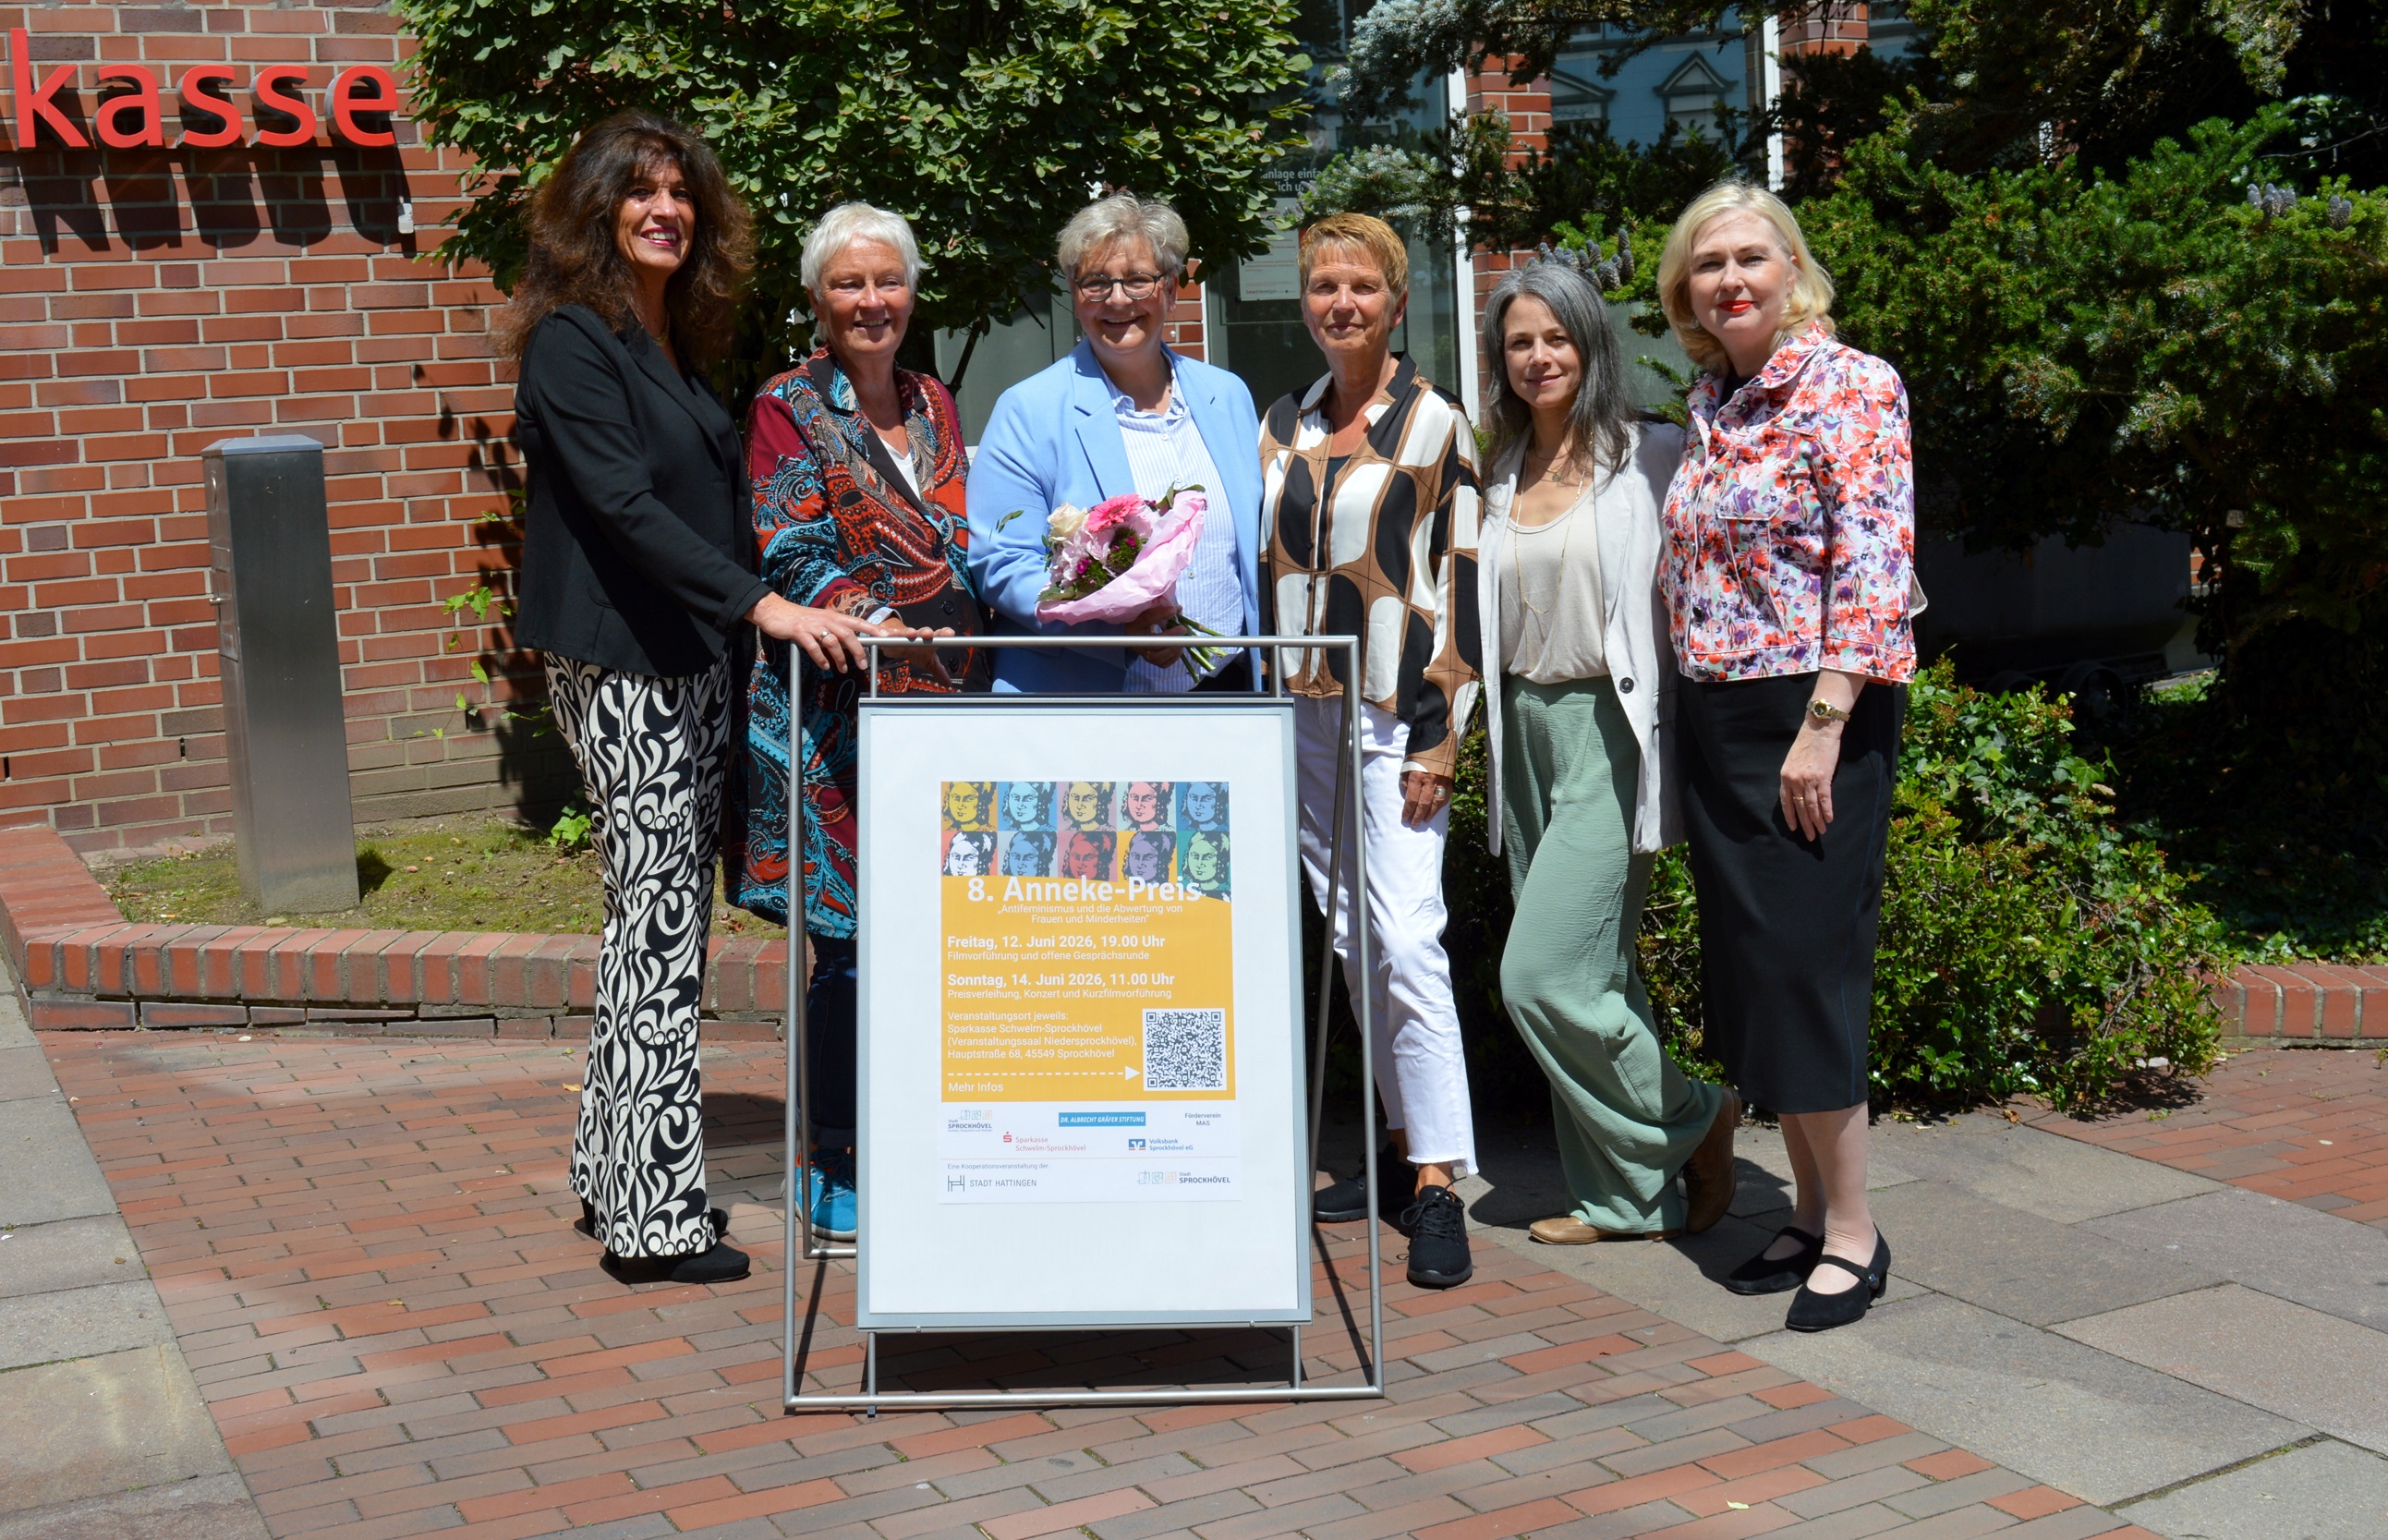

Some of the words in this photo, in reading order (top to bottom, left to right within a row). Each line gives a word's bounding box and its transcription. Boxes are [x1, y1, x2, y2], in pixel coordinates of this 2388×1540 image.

[10, 28, 397, 149] kasse
[1260, 168, 1294, 181] anlage
[968, 877, 993, 901] 8.
[1003, 875, 1201, 901] Anneke-Preis
[1077, 904, 1096, 913] und
[1097, 904, 1110, 913] die
[1113, 904, 1162, 915] Abwertung
[1032, 915, 1062, 923] Frauen
[1066, 915, 1082, 923] und
[948, 936, 998, 950] Freitag,
[1002, 936, 1022, 948] 12.
[1027, 936, 1055, 948] Juni
[1059, 936, 1096, 950] 2026,
[1101, 936, 1138, 947] 19.00
[1142, 935, 1165, 947] Uhr
[948, 951, 1018, 962] Filmvorführung
[1021, 951, 1038, 960] und
[1041, 951, 1070, 960] offene
[1073, 951, 1149, 962] Gesprächsrunde
[948, 974, 1007, 988] Sonntag,
[1011, 974, 1031, 985] 14.
[1036, 974, 1064, 986] Juni
[1069, 973, 1106, 988] 2026,
[1110, 973, 1147, 985] 11.00
[1152, 973, 1174, 985] Uhr
[948, 989, 1022, 1000] Preisverleihung,
[1024, 989, 1060, 998] Konzert
[1062, 989, 1080, 998] und
[1083, 988, 1171, 1000] Kurzfilmvorführung
[948, 1012, 1031, 1022] Veranstaltungsort
[1033, 1012, 1068, 1022] jeweils:
[948, 1024, 996, 1034] Sparkasse
[1000, 1024, 1102, 1034] Schwelm-Sprockhövel
[948, 1037, 1041, 1047] (Veranstaltungssaal
[1044, 1036, 1137, 1047] Niedersprockhövel),
[948, 1049, 1006, 1060] Hauptstraße
[1009, 1049, 1023, 1060] 68,
[1025, 1049, 1054, 1058] 45549
[1057, 1049, 1114, 1060] Sprockhövel
[949, 1082, 975, 1092] Mehr
[977, 1082, 1003, 1092] Infos
